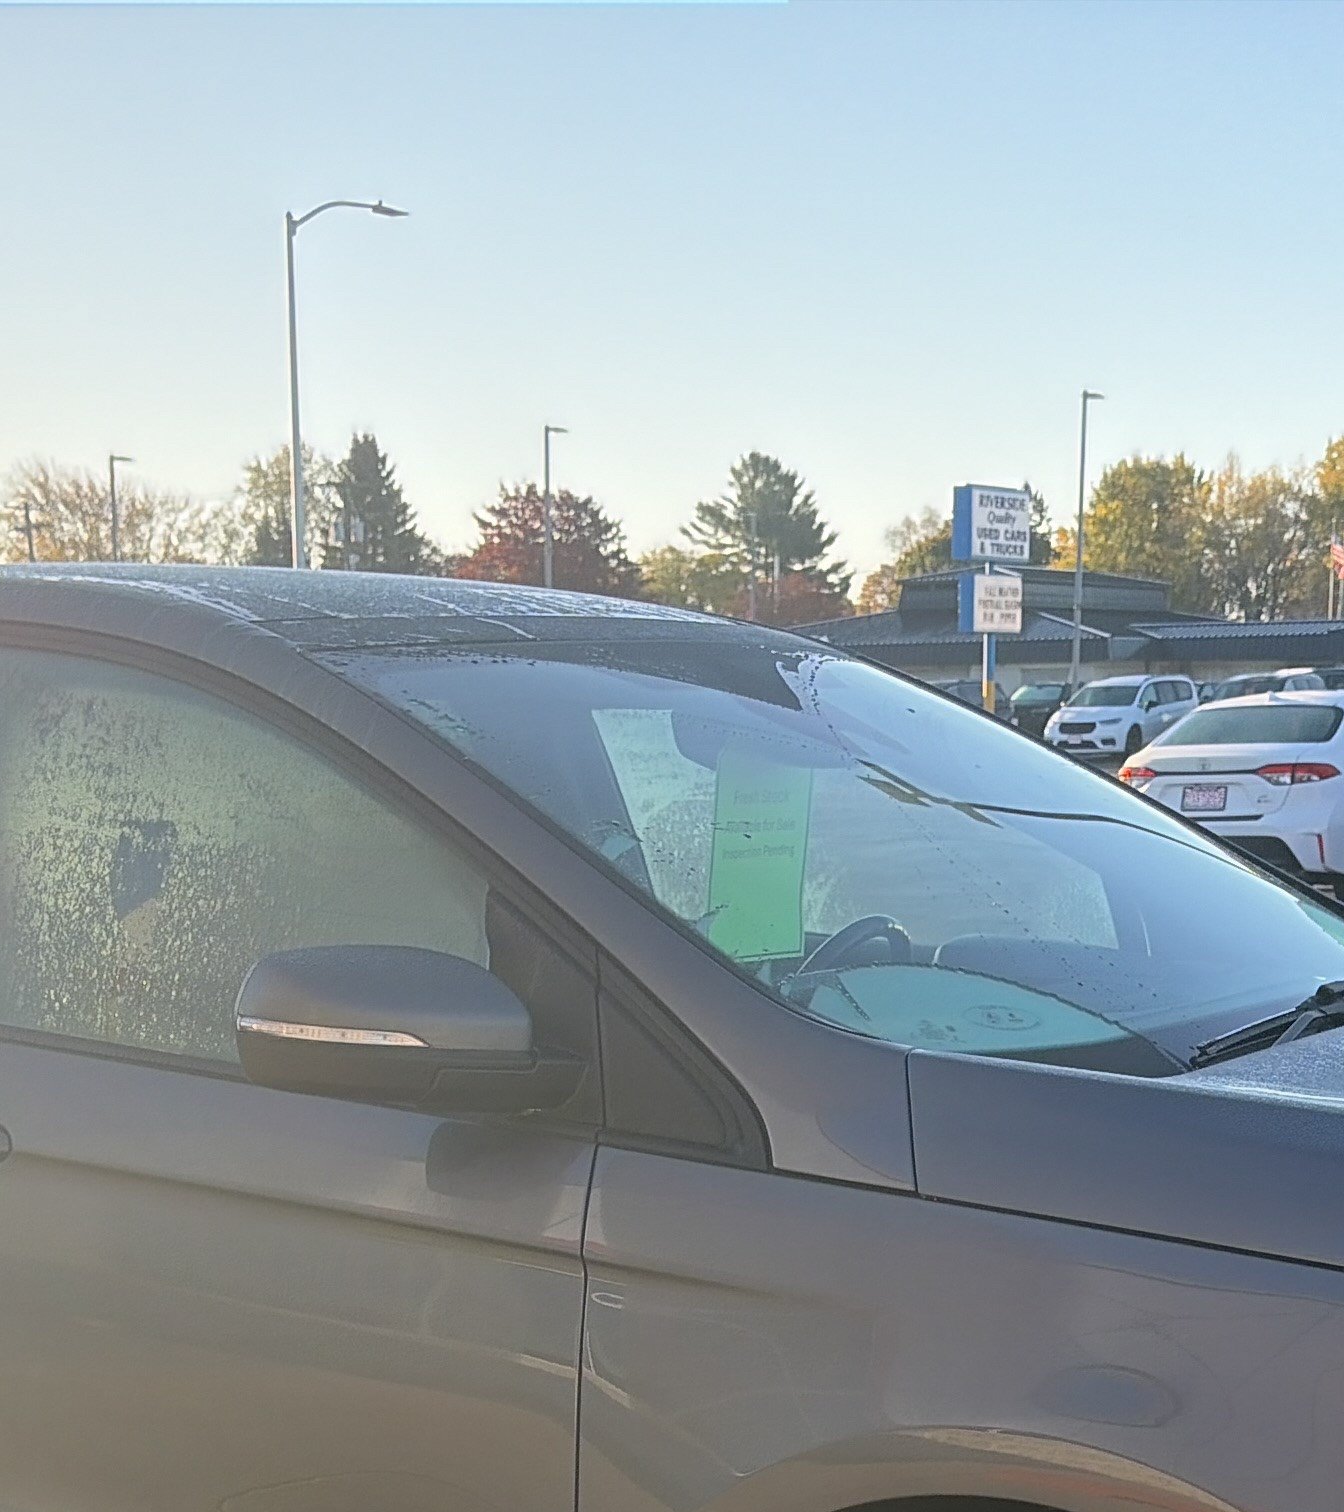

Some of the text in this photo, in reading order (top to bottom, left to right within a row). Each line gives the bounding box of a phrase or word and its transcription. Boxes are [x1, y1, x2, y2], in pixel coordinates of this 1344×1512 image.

[979, 493, 1027, 511] RIVERSIDE
[976, 527, 1027, 542] USED CARS
[990, 542, 1025, 556] TRUCKS
